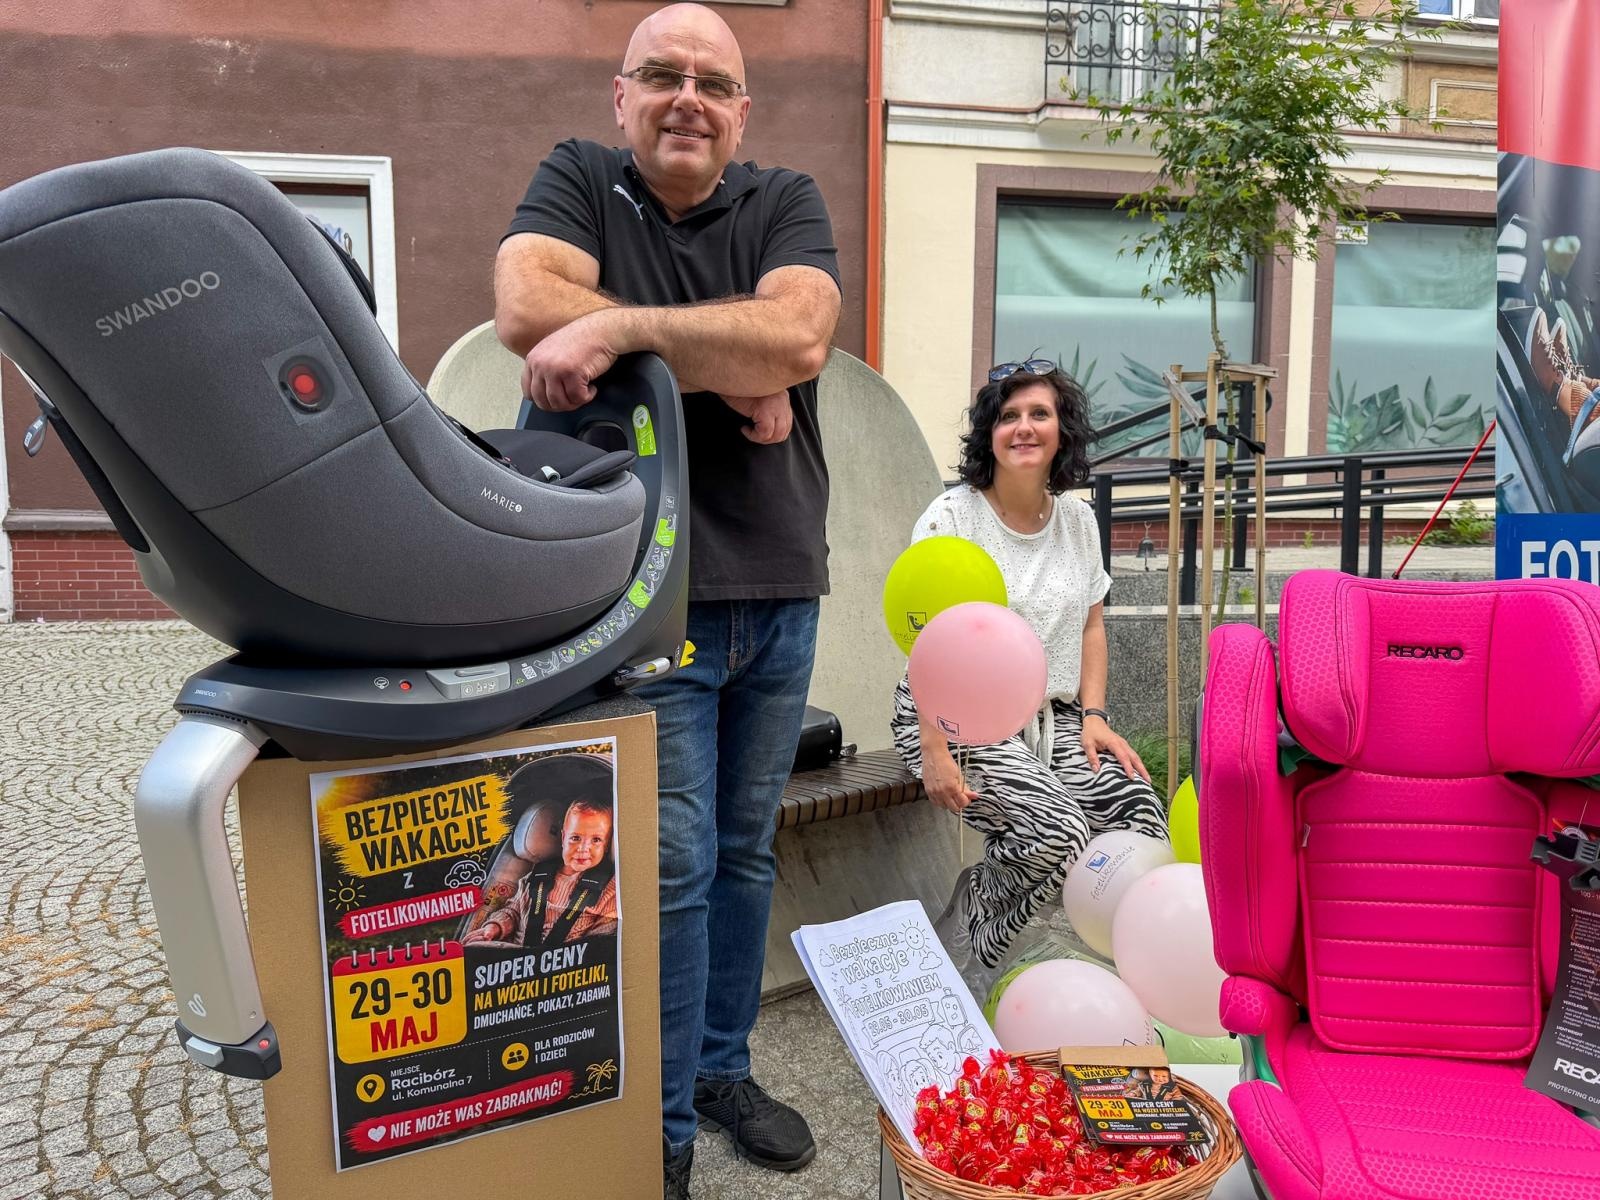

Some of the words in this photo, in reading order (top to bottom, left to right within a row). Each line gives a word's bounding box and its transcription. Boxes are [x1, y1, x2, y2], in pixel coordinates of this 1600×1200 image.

[95, 271, 220, 336] SWANDOO
[1388, 645, 1464, 661] RECARO
[345, 781, 490, 841] BEZPIECZNE
[360, 814, 491, 872] WAKACJE
[350, 890, 475, 935] FOTELIKOWANIEM
[829, 932, 898, 963] Bezpieczne
[474, 954, 536, 989] SUPER
[540, 942, 589, 974] CENY
[840, 948, 910, 984] wakacje
[349, 968, 452, 1019] 29-30
[474, 990, 493, 1011] NA
[497, 979, 540, 1006] WÓZKI
[543, 977, 548, 995] I
[551, 963, 609, 993] FOTELIKI,
[850, 972, 942, 1018] FOTELIKOWANIEM
[473, 1004, 535, 1030] DMUCHAŃCE,
[537, 994, 574, 1015] POKAZY,
[576, 984, 611, 1006] ZABAWA
[897, 1004, 930, 1025] 30.05
[370, 1011, 438, 1053] MAJ
[534, 1039, 551, 1051] DLA
[552, 1027, 595, 1047] RODZICÓW
[390, 1064, 421, 1078] MIEJSCE
[535, 1054, 538, 1064] I
[540, 1047, 567, 1062] DZIECI
[391, 1068, 456, 1091] Racibórz
[392, 1091, 405, 1101] ul.
[407, 1079, 465, 1098] Komunalna
[466, 1075, 473, 1084] 7
[1081, 1068, 1124, 1079] WAKACJE
[1548, 1081, 1587, 1099] PROTECTING
[390, 1120, 411, 1140] NIE
[415, 1109, 451, 1134] MOŻE
[454, 1103, 483, 1123] WAS
[486, 1079, 563, 1115] ZABRAKNĄĆ!
[1088, 1100, 1125, 1109] 29-30
[1097, 1109, 1123, 1118] MAJ
